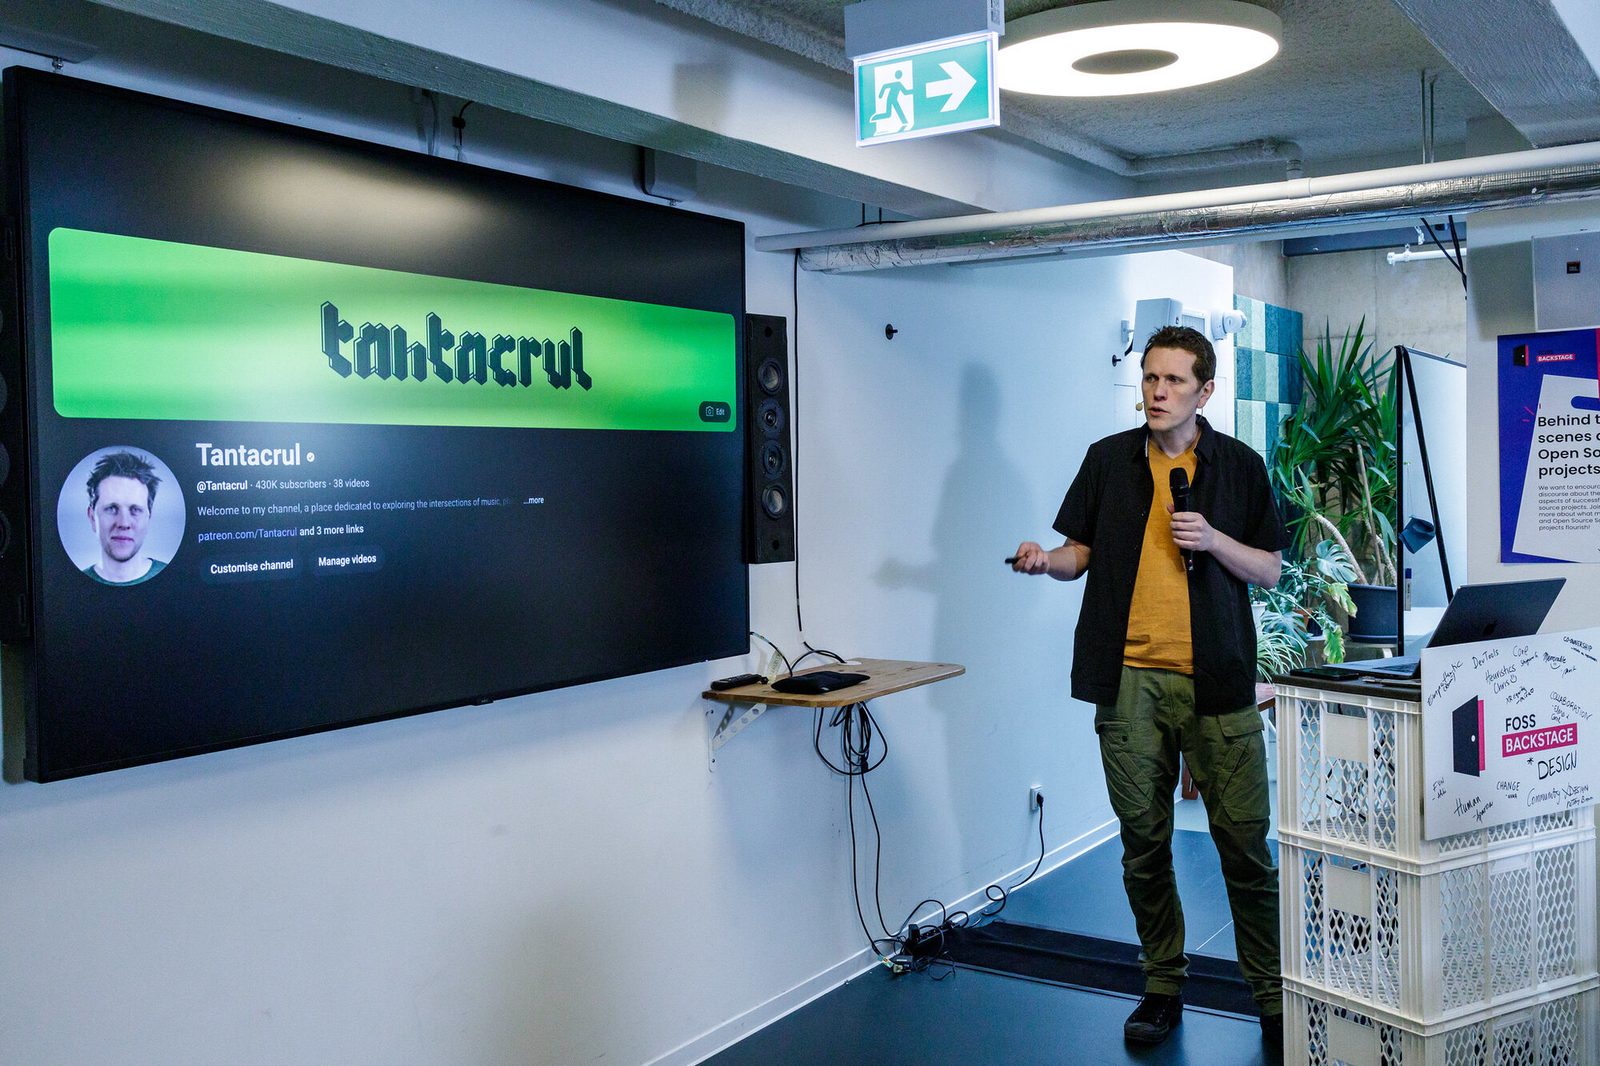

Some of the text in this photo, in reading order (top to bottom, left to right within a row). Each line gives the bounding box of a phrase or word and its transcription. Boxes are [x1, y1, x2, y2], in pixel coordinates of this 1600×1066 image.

[320, 300, 592, 391] tantacrul
[1538, 353, 1573, 362] BACKSTAGE
[715, 406, 725, 416] Edit
[1538, 414, 1591, 427] Behind
[1538, 432, 1592, 444] scenes
[195, 442, 301, 467] Tantacrul
[1538, 449, 1579, 463] Open
[1538, 463, 1600, 480] projects
[196, 479, 370, 494] @Tantacrul 430K subscribers 38 videos
[197, 506, 240, 516] Welcome
[241, 506, 251, 515] to
[252, 507, 266, 516] my
[267, 503, 303, 514] channel,
[311, 503, 333, 514] place
[334, 501, 372, 512] dedicated
[373, 502, 381, 510] to
[382, 500, 415, 510] exploring
[416, 500, 428, 508] the
[429, 499, 472, 508] intersections
[473, 497, 480, 506] of
[198, 524, 365, 543] patreon.com/Tantacrul and 3 more links
[210, 559, 294, 575] Customise channel
[318, 554, 377, 567] Manage videos
[1472, 649, 1499, 669] DevTools
[1485, 664, 1516, 685] Heuristics
[1493, 680, 1510, 694] Chris
[1549, 691, 1593, 720] COLLABORATION
[1506, 714, 1536, 732] FOSS
[1505, 728, 1573, 753] BACKSTAGE
[1538, 750, 1577, 780] DESIGN
[1496, 781, 1521, 792] CHANGE
[1527, 787, 1561, 807] Community
[1453, 796, 1482, 817] Human
